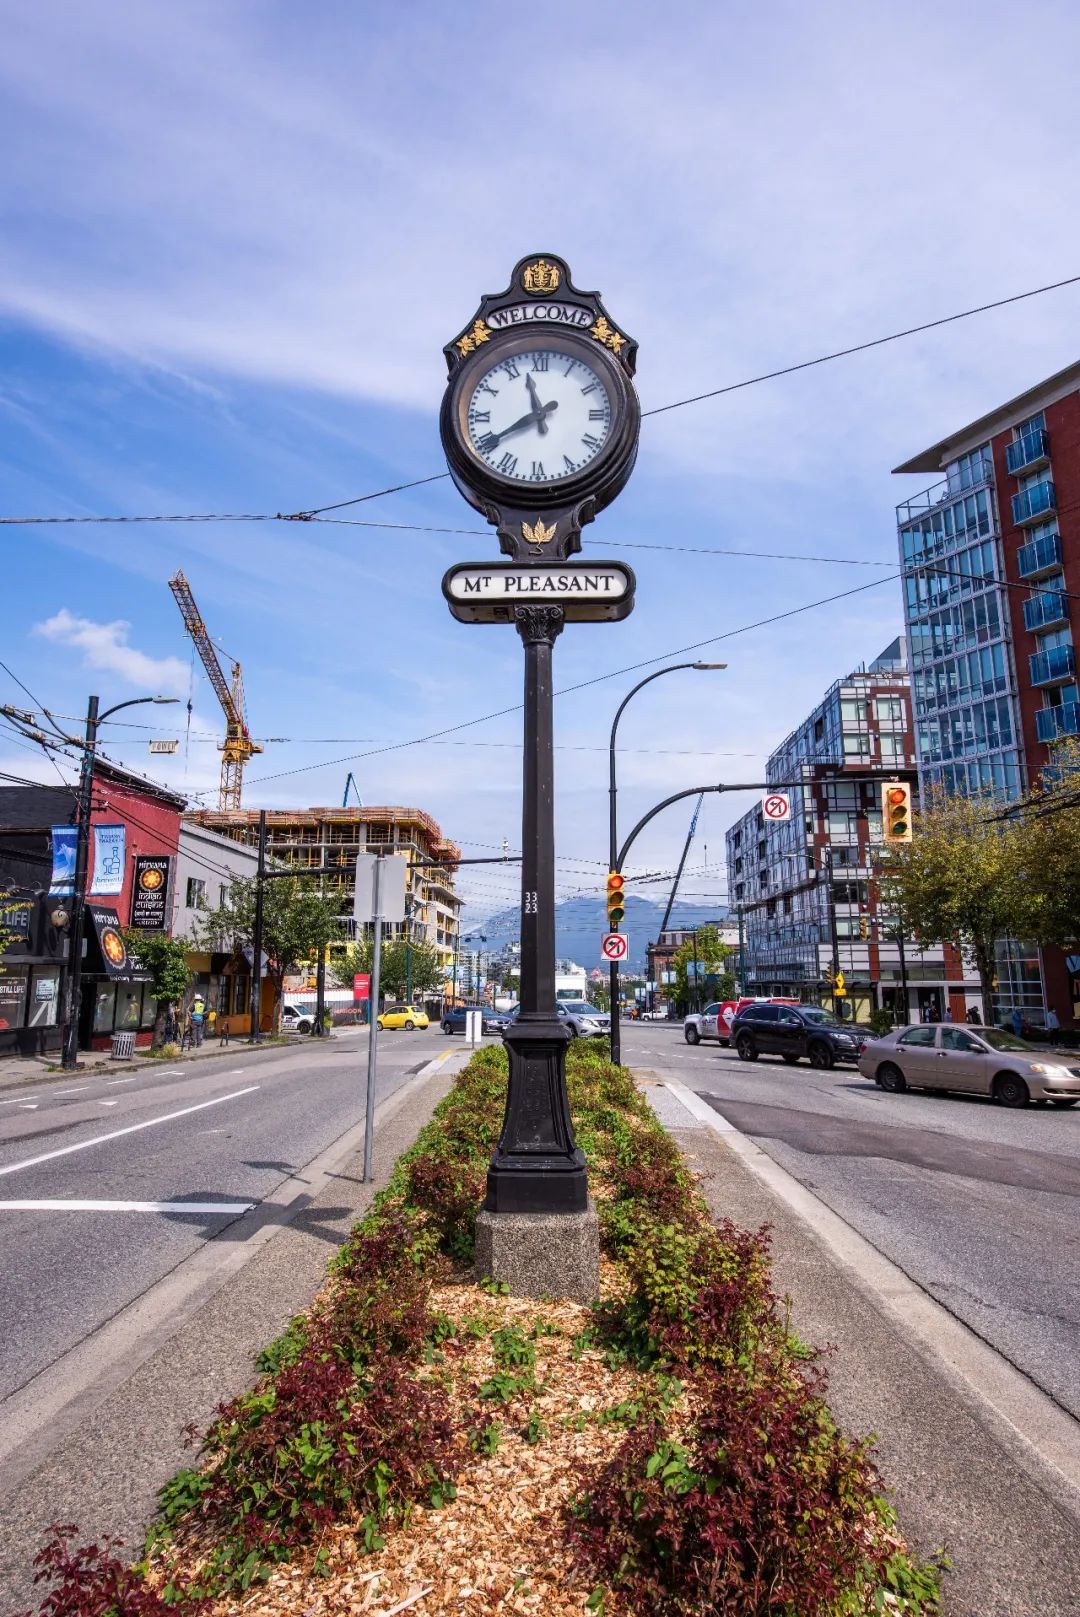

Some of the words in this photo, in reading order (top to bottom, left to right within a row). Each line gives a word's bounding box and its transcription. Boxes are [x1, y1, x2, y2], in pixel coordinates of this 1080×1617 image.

[492, 305, 590, 327] WELCOME
[531, 357, 549, 372] XII
[504, 364, 521, 381] XI
[482, 385, 499, 397] X
[580, 383, 598, 396] II
[474, 410, 491, 423] IX
[588, 409, 605, 421] III
[581, 432, 598, 450] IV
[499, 452, 519, 472] VII
[532, 461, 545, 476] VI
[563, 455, 575, 469] V
[463, 576, 492, 592] MT
[504, 575, 614, 592] PLEASANT
[525, 892, 537, 902] 33
[525, 903, 537, 913] 23
[6, 911, 28, 927] LIFE
